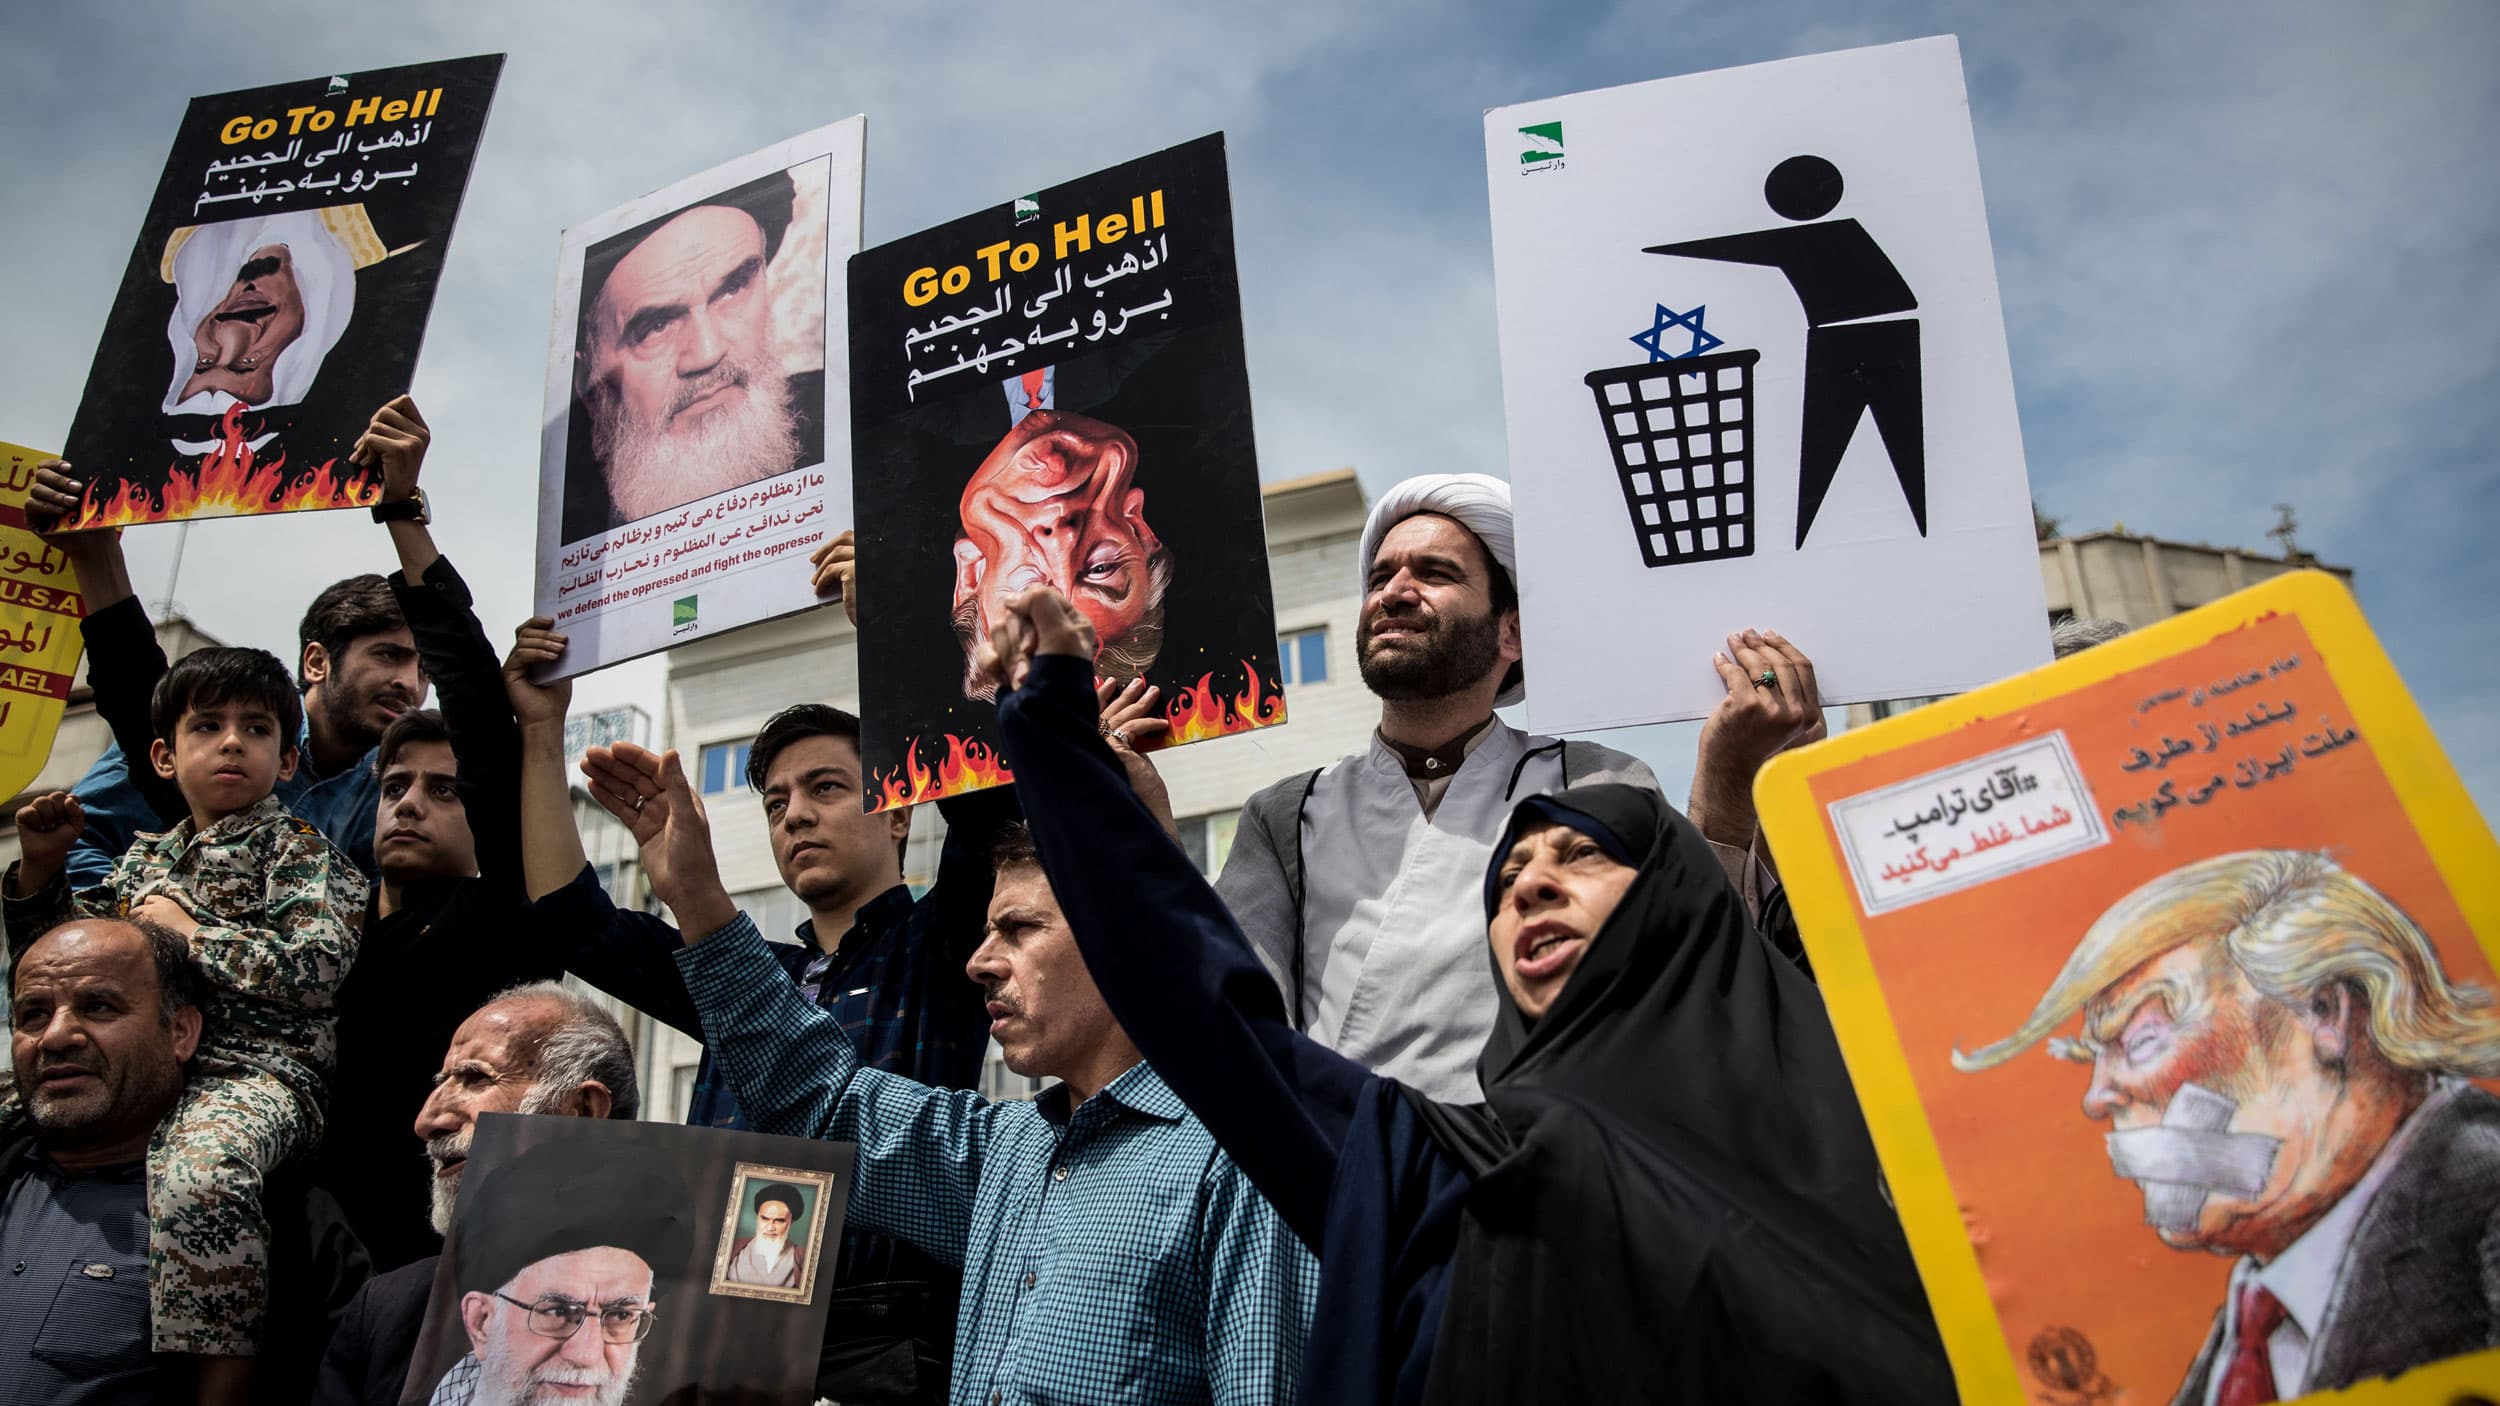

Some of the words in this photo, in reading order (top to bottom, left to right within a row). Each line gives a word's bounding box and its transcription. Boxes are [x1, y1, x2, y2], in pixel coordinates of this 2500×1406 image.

[220, 116, 278, 145] Go
[287, 106, 336, 136] To
[344, 87, 443, 128] Hell
[358, 120, 433, 161] اذهب
[193, 176, 296, 218] جهنم
[903, 265, 971, 307] Go
[976, 239, 1040, 282] To
[1053, 189, 1166, 261] Hell
[1083, 232, 1169, 298] اذهب
[907, 337, 1026, 403] جهنم
[749, 481, 794, 510] مظلوم
[795, 474, 807, 496] از
[810, 472, 825, 487] ما
[716, 494, 748, 520] دفاع
[794, 499, 824, 525] نحن
[719, 527, 742, 547] عن
[745, 509, 791, 539] ندافع
[652, 553, 660, 568] و
[663, 532, 715, 565] المظلوم
[557, 608, 573, 621] we
[574, 595, 610, 615] defend
[613, 588, 630, 601] the
[632, 569, 689, 597] oppressed
[690, 561, 712, 578] and
[714, 551, 740, 573] fight
[742, 545, 761, 562] the
[763, 530, 824, 557] oppressor
[558, 568, 603, 599] الظالم
[606, 552, 650, 582] نحارب
[0, 580, 79, 614] U.S.A
[2226, 701, 2297, 737] بنده
[2196, 722, 2220, 752] از
[2121, 736, 2194, 773] طرف
[2234, 743, 2297, 788] ایران
